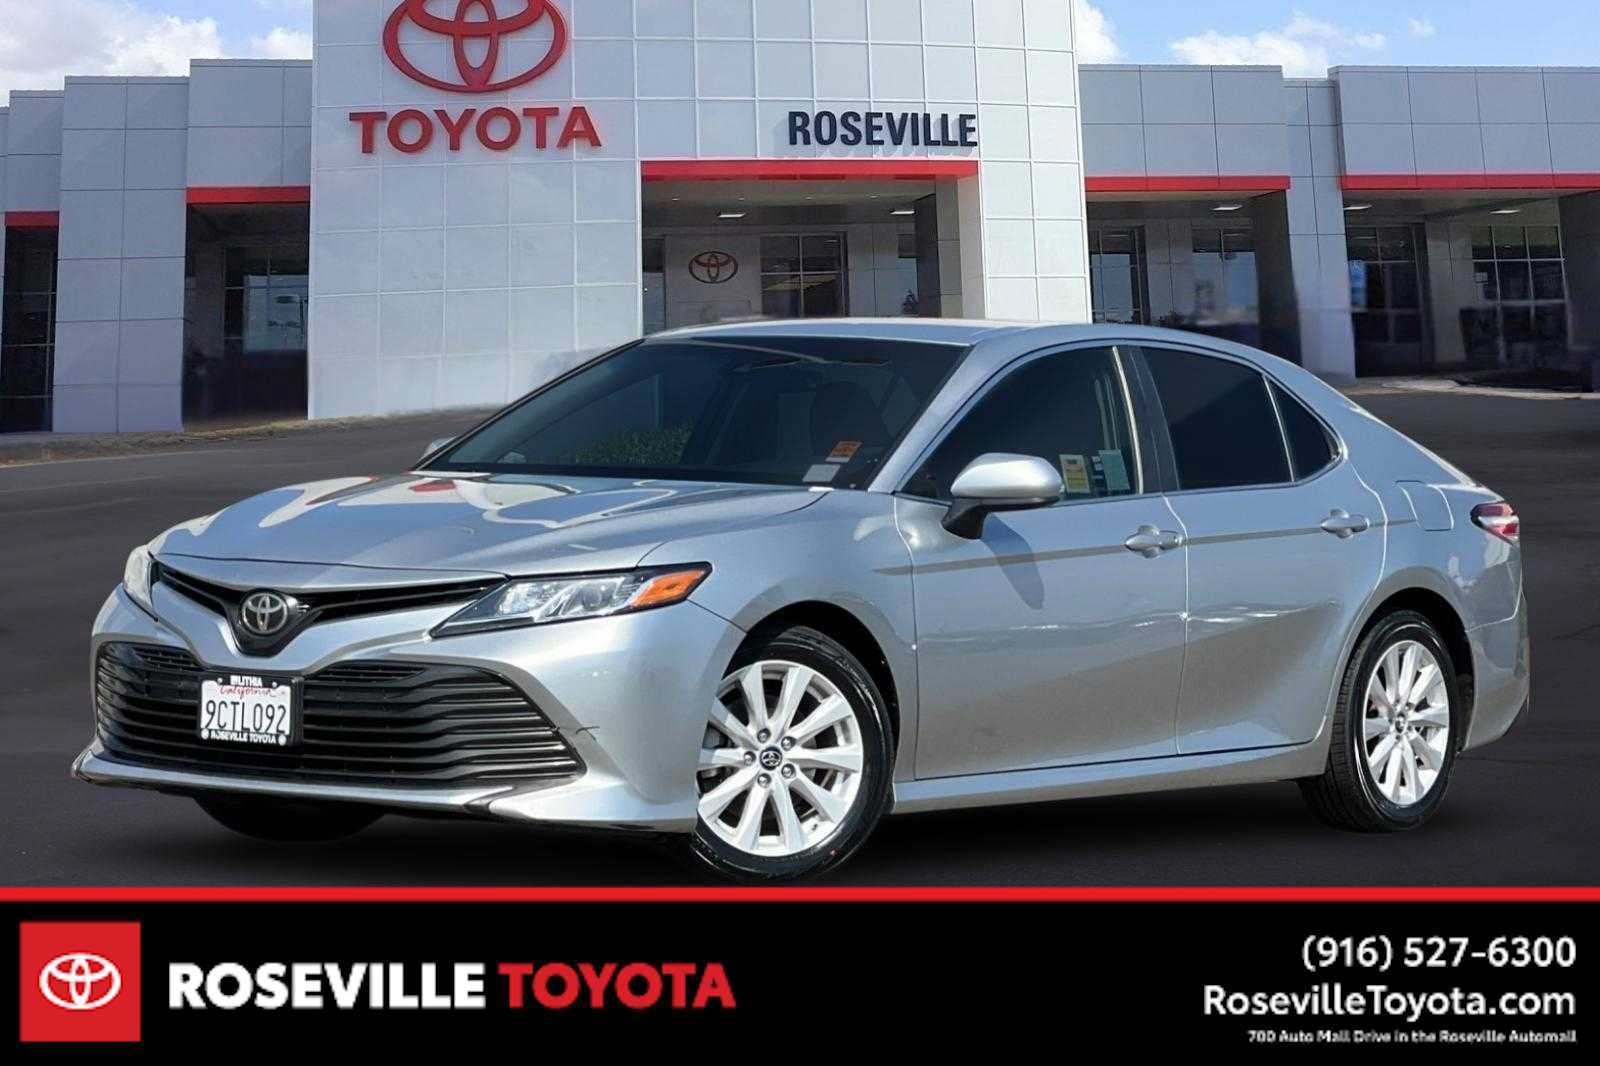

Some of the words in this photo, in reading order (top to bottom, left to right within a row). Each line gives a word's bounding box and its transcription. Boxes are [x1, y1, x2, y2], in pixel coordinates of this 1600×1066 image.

[349, 105, 602, 153] TOYOTA
[789, 111, 978, 147] ROSEVILLE
[205, 700, 286, 734] 9CTL092
